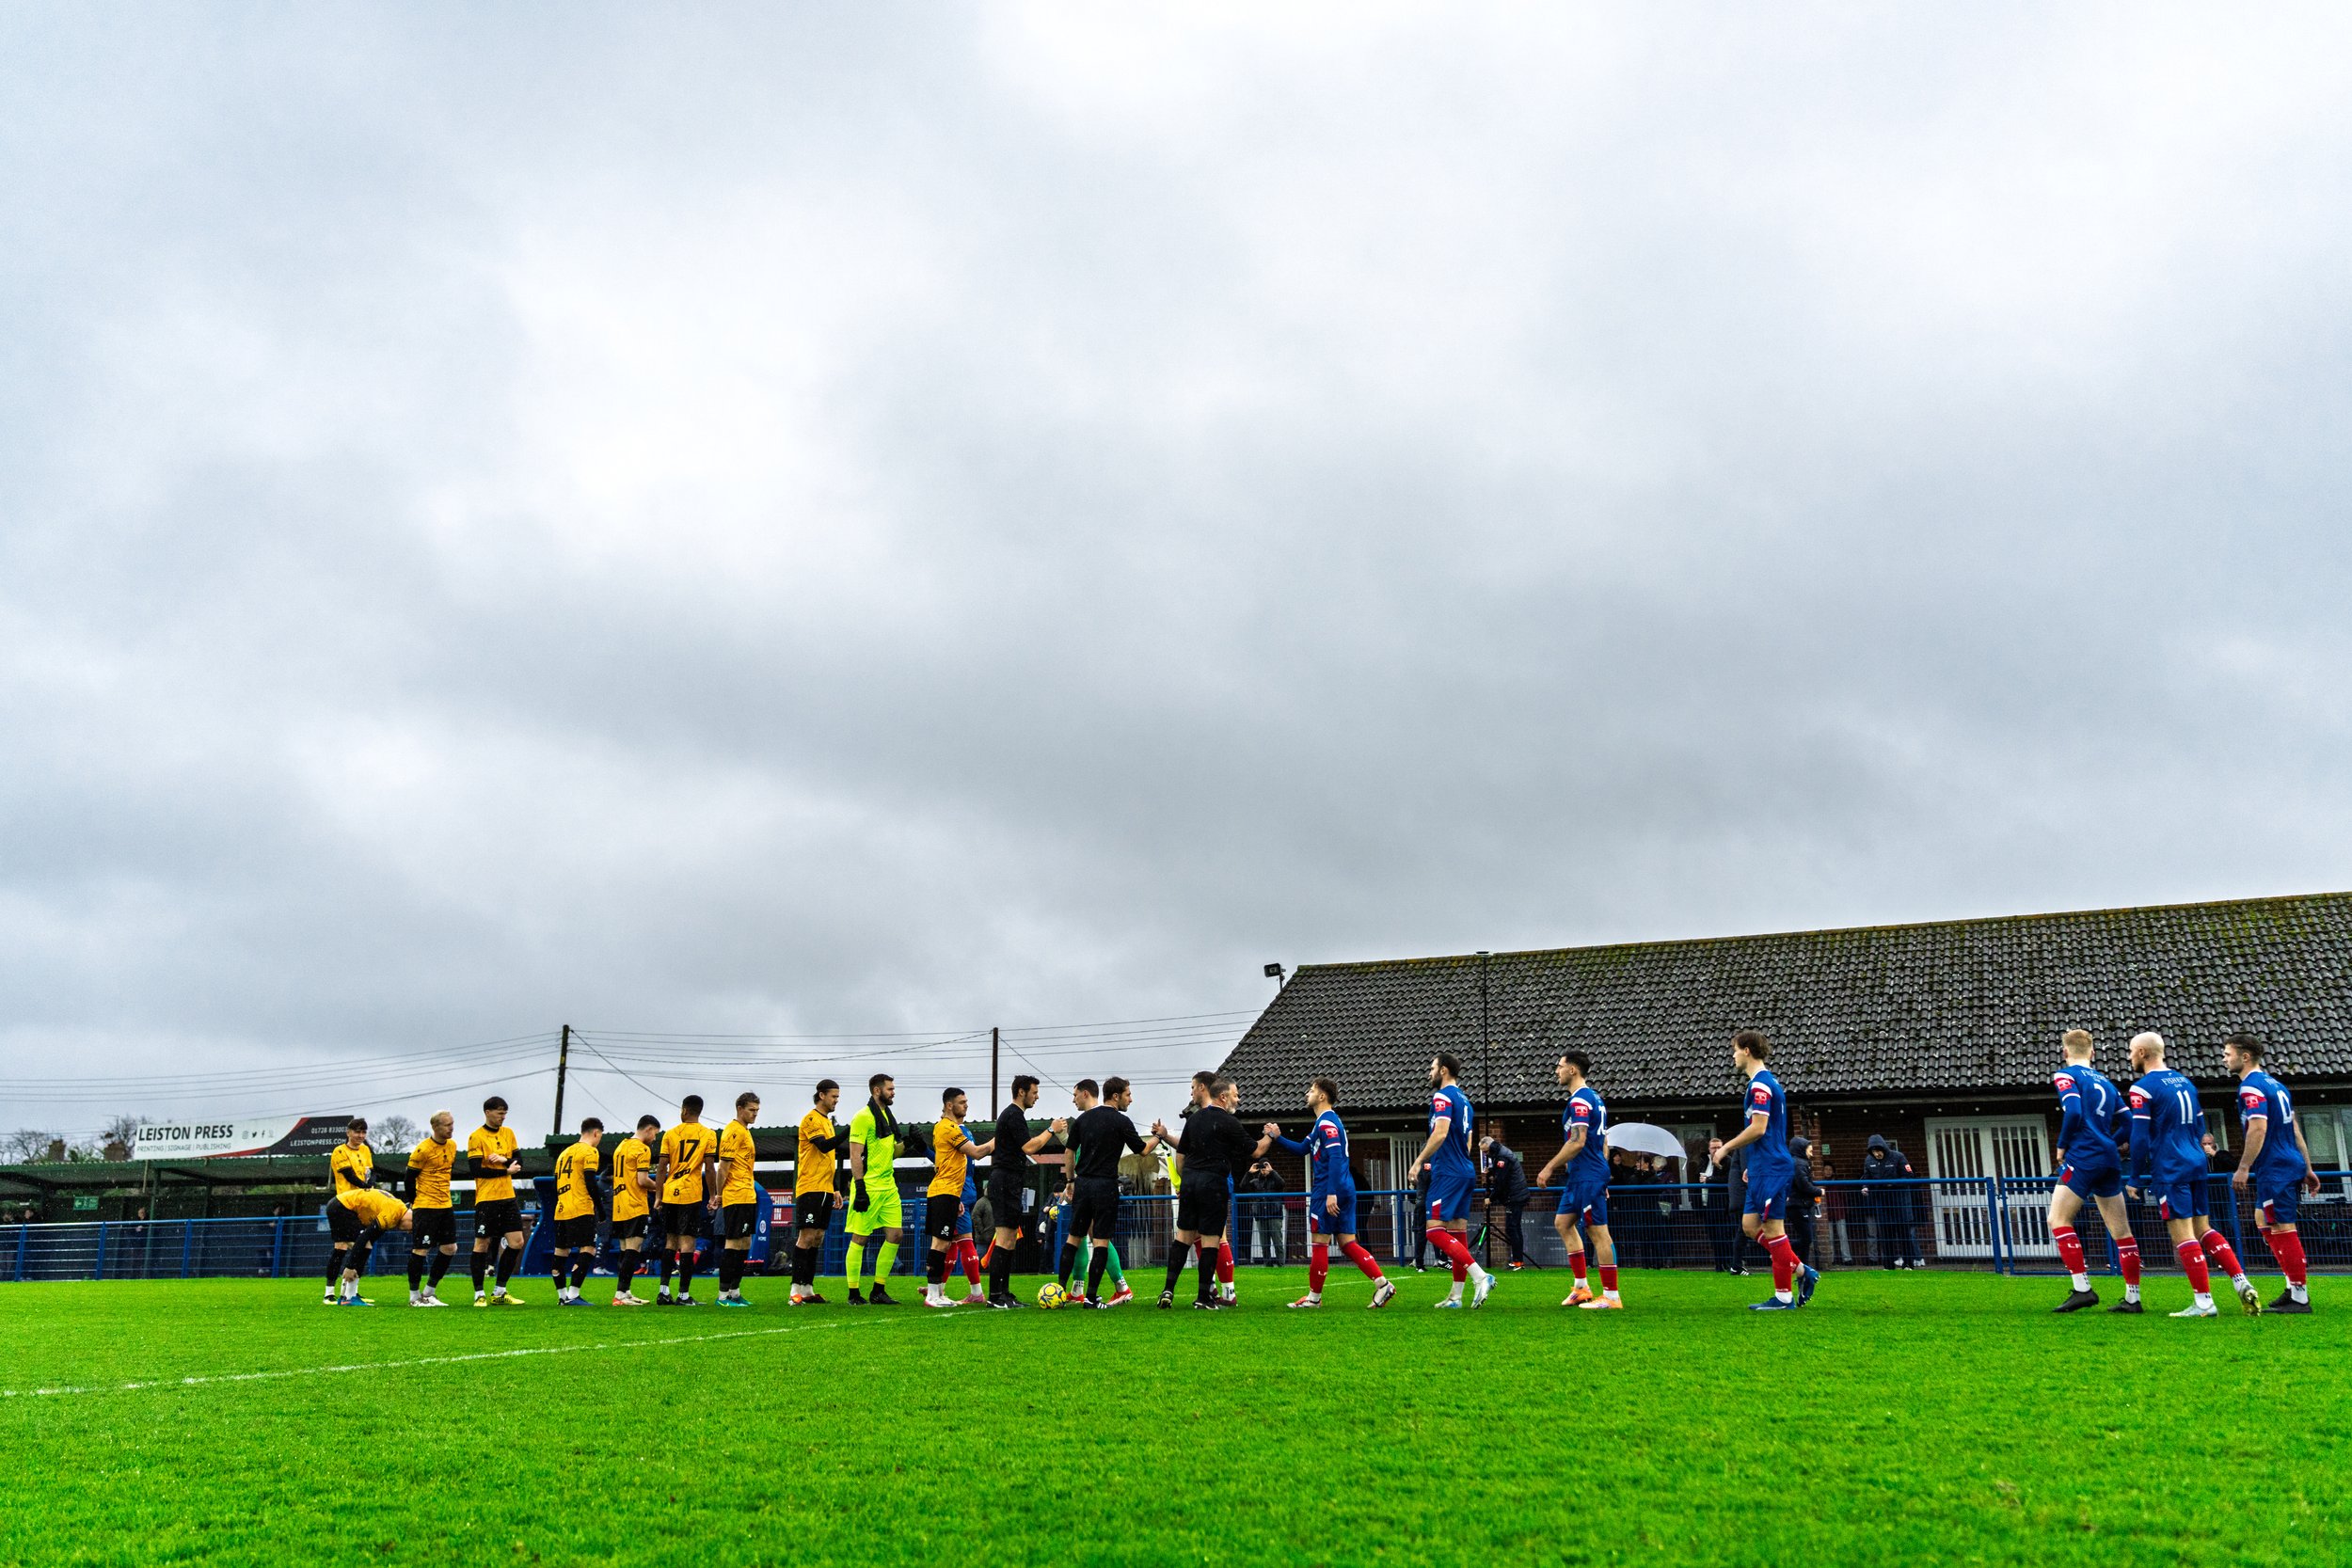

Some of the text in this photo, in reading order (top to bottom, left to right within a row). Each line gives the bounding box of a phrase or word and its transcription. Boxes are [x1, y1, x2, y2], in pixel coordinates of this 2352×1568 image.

[2093, 1083, 2106, 1117] 2
[2176, 1089, 2193, 1125] 11
[138, 1124, 233, 1141] LEISTON PRESS
[290, 1138, 347, 1147] LEISTONPRESS.COM
[196, 1142, 232, 1151] PUBLISHING
[678, 1139, 700, 1163] 17
[558, 1155, 573, 1180] 14
[615, 1155, 625, 1178] 11
[2210, 1243, 2231, 1254] LFC
